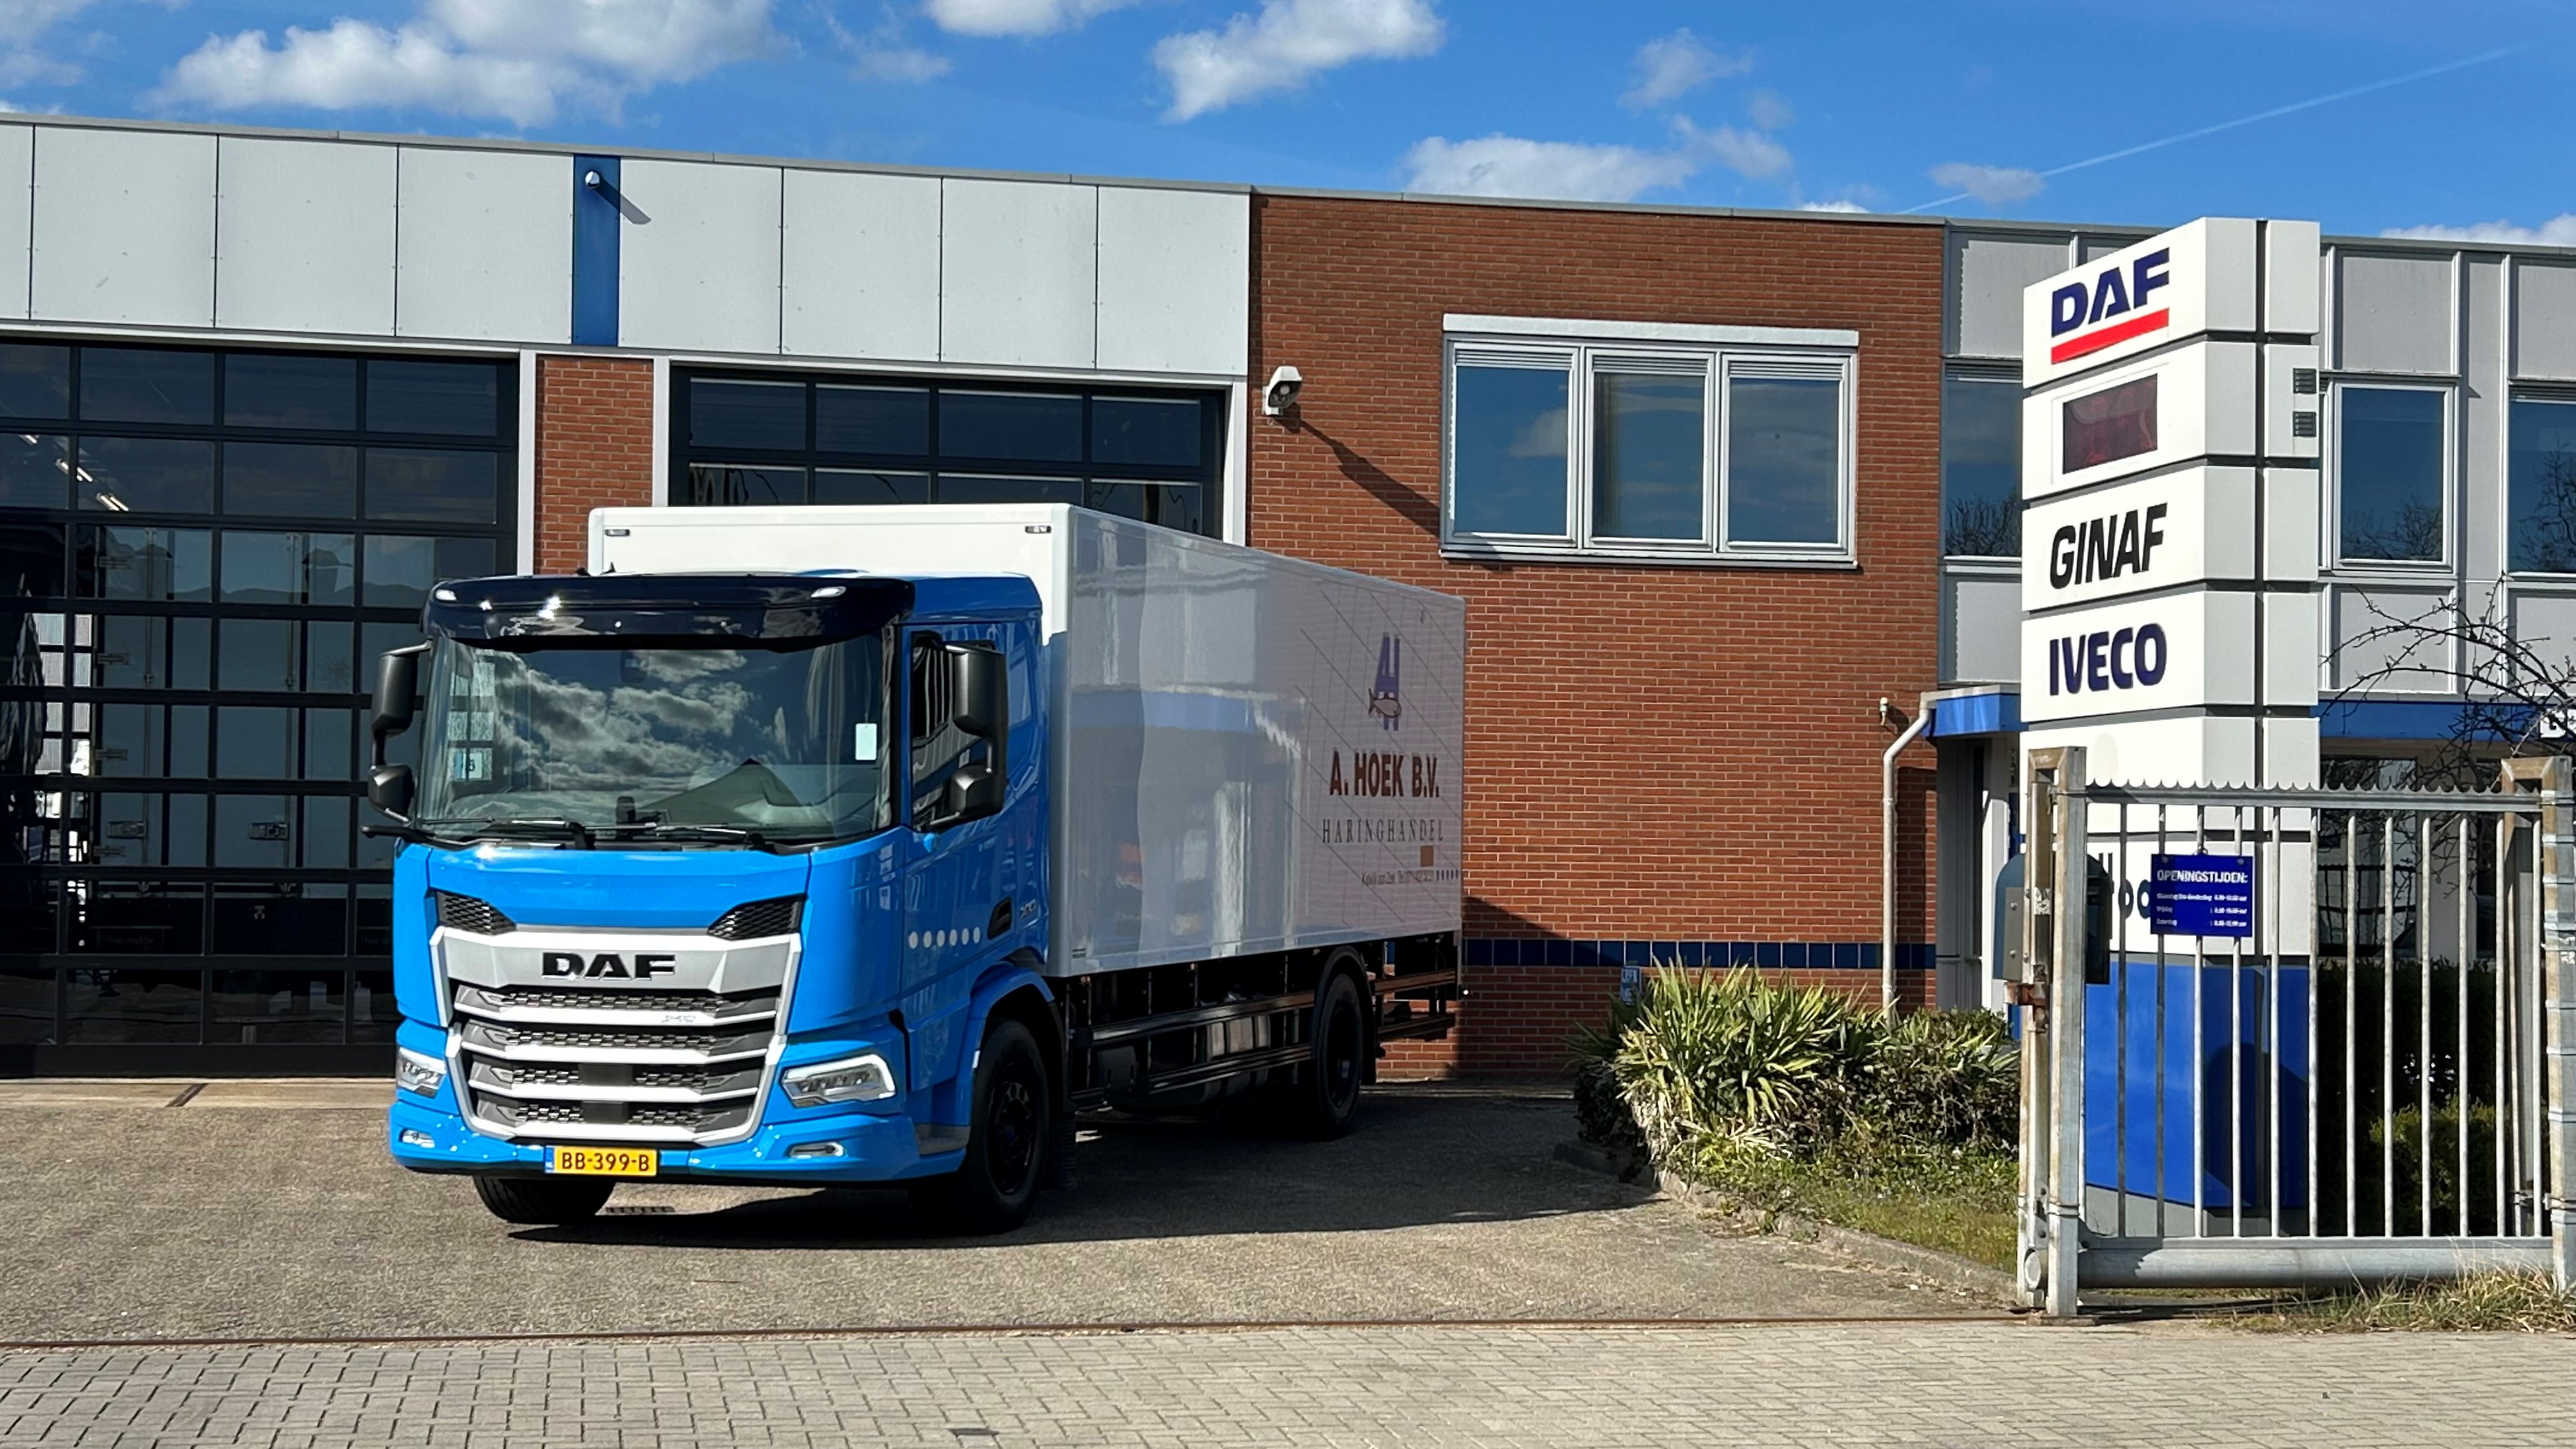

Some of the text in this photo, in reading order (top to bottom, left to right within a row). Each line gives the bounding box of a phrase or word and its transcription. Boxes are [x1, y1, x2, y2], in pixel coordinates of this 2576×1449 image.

[2051, 247, 2169, 338] DAF
[2050, 503, 2167, 590] GINAF
[2050, 623, 2166, 696] IVECO
[1330, 751, 1440, 798] A. HOEK B.V.
[1322, 818, 1444, 843] HARINGHANDEL
[2156, 870, 2248, 883] OPENINGSTIJDEN:
[542, 953, 675, 980] DAF
[562, 1152, 650, 1172] BB-399-B
